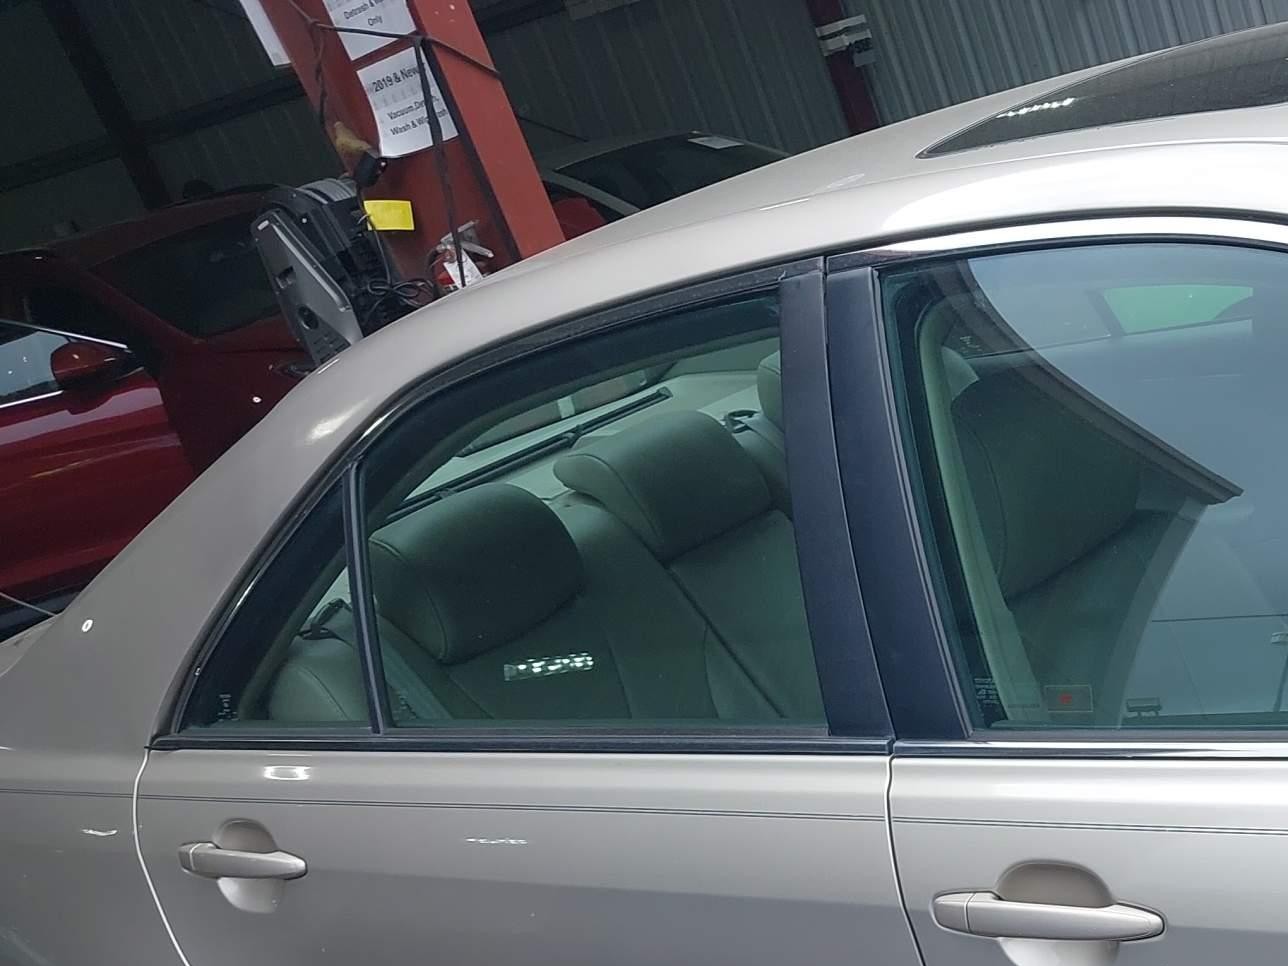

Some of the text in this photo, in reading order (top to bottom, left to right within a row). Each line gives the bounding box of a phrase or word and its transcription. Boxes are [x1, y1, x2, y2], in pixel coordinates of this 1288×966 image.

[367, 15, 383, 26] Only
[372, 75, 394, 92] 2019
[392, 72, 402, 83] &
[390, 122, 411, 135] Wash
[410, 120, 418, 129] &
